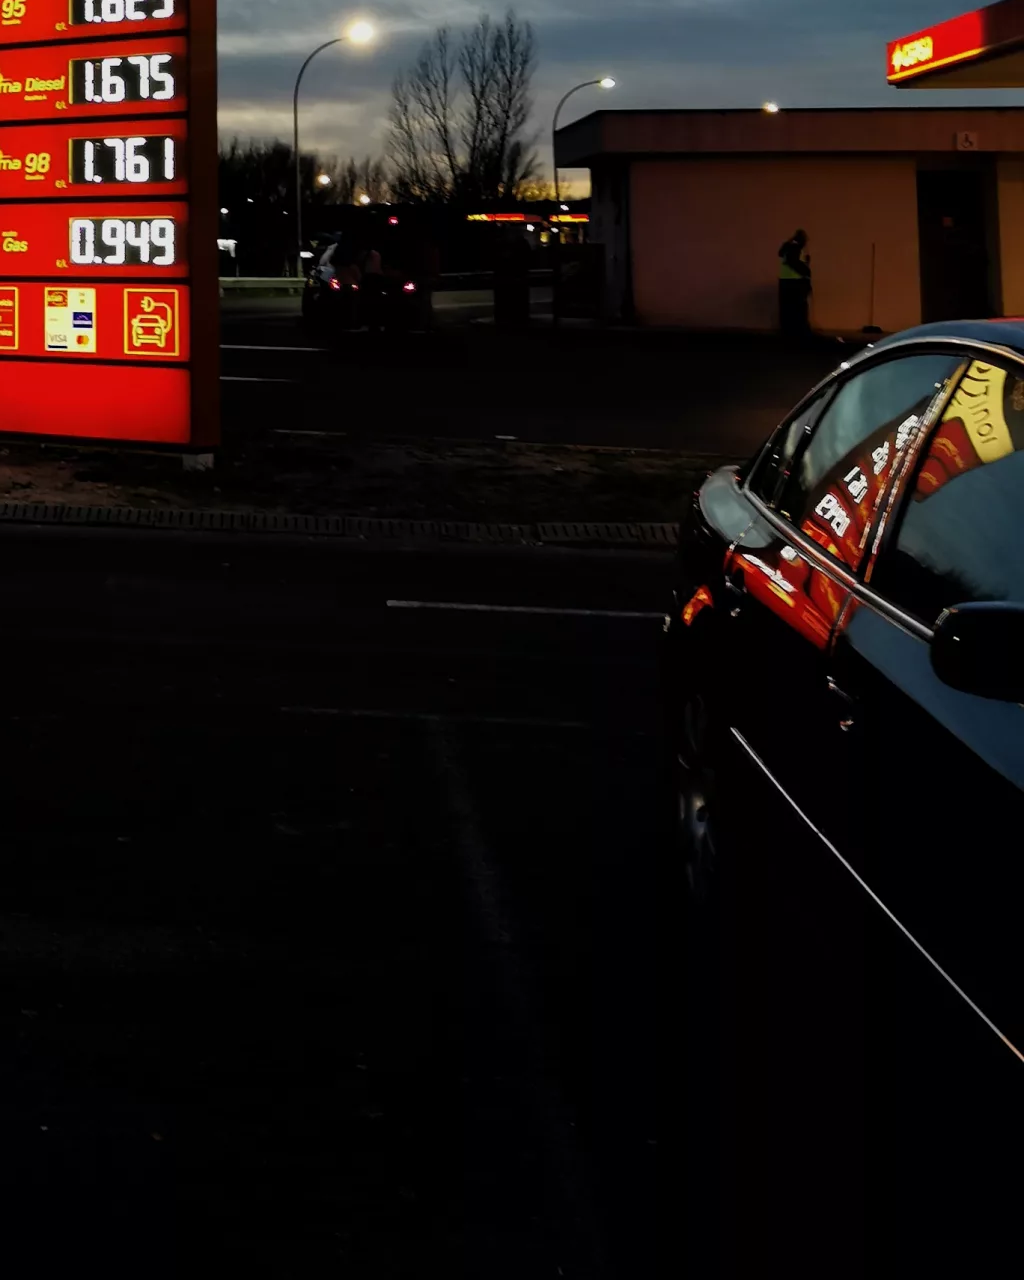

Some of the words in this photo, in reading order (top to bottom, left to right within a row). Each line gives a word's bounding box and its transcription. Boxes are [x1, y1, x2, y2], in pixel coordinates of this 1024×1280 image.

[25, 75, 65, 92] Diesel
[84, 54, 174, 103] 1.675
[25, 153, 51, 174] 98
[84, 137, 174, 183] 1.761
[3, 236, 28, 252] Gas
[71, 219, 175, 266] 0.949
[49, 333, 68, 343] VISA
